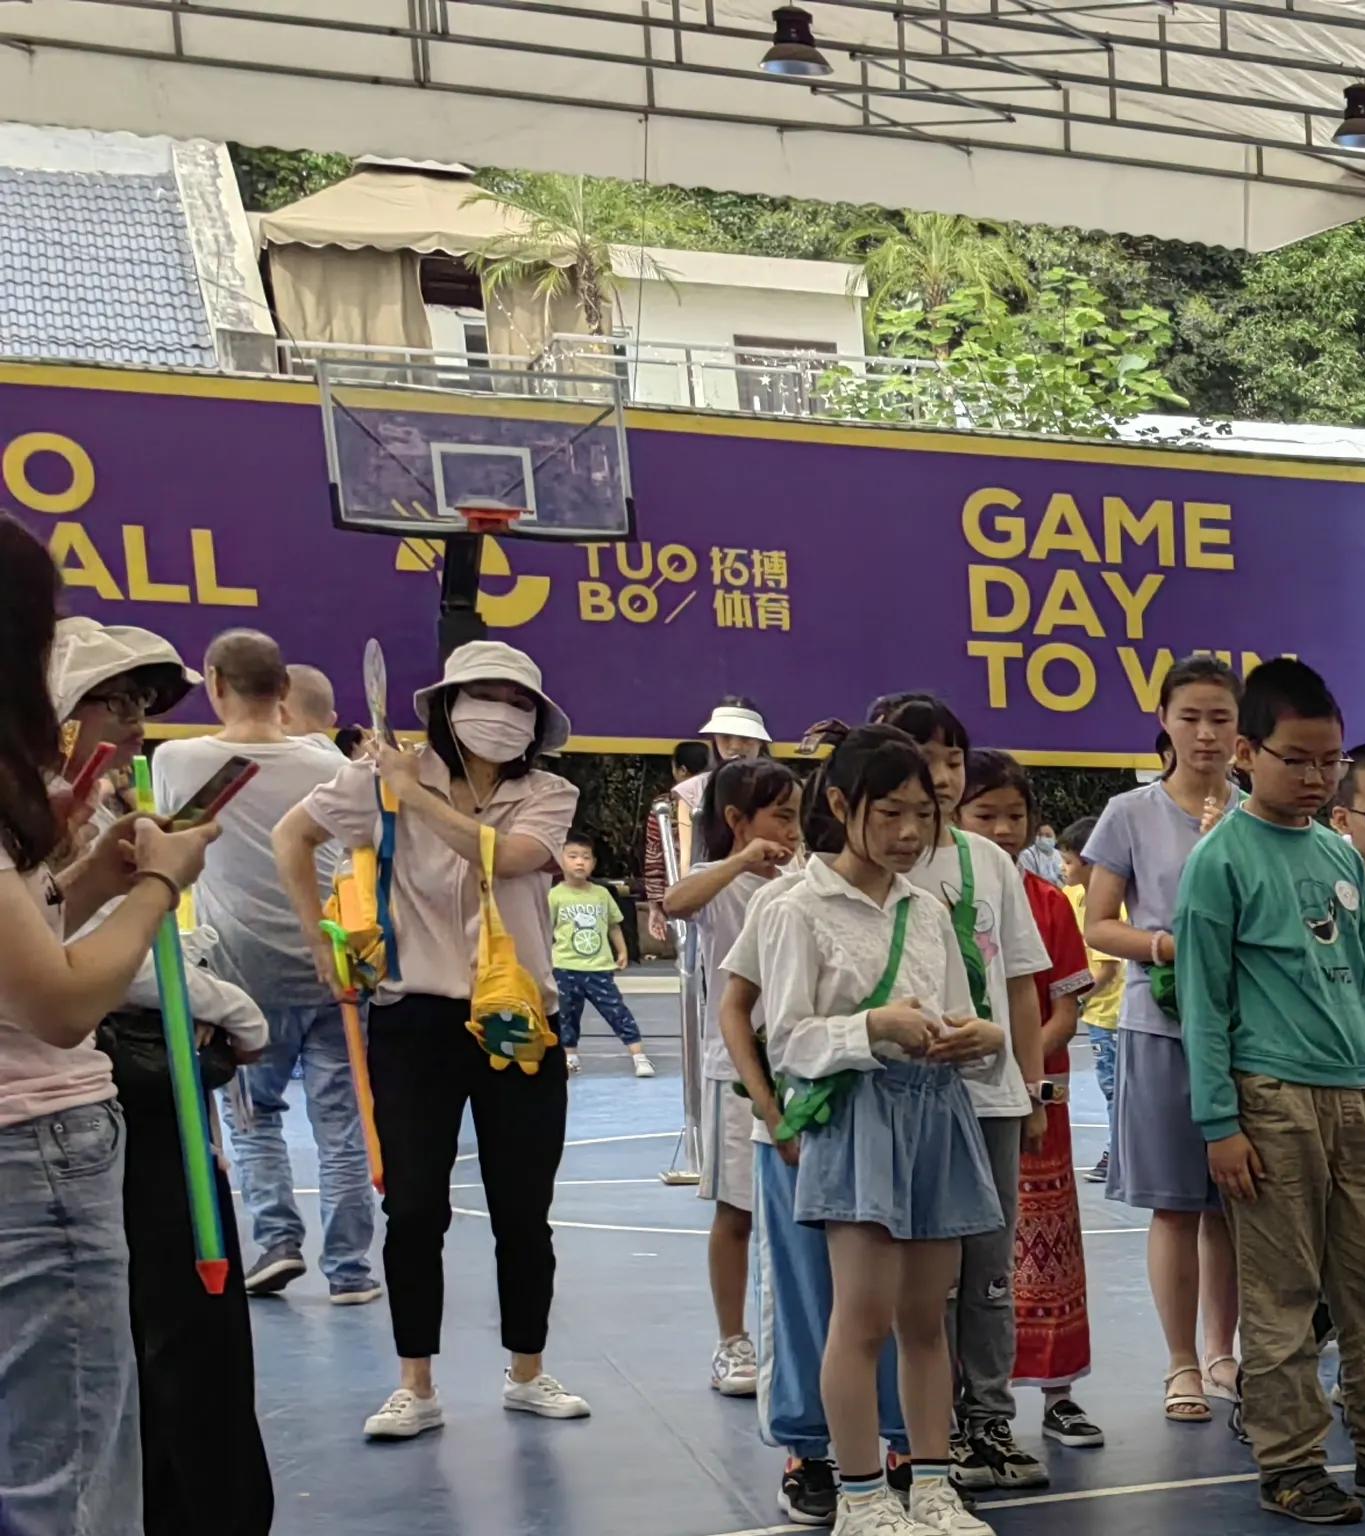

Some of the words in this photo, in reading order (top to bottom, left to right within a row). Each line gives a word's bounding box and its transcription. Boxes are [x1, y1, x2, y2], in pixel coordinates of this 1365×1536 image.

[575, 541, 697, 582] TUO
[962, 487, 1235, 569] GAME
[713, 589, 790, 631] 体育
[968, 564, 1165, 639] DAY
[967, 640, 1097, 712] TO
